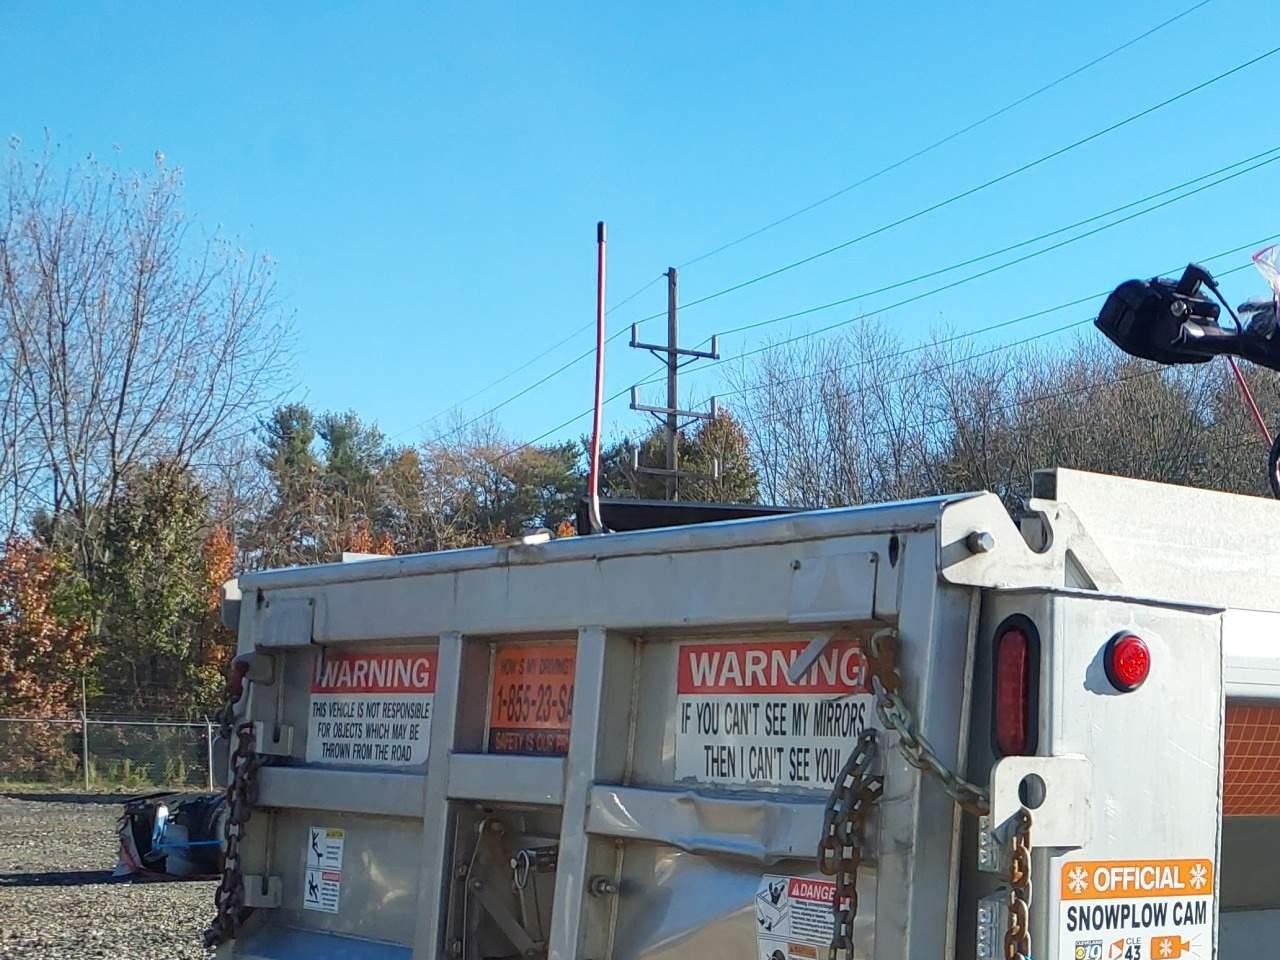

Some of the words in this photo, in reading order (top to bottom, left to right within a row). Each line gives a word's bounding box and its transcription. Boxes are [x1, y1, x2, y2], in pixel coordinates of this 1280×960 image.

[315, 658, 430, 688] WARNING
[689, 648, 866, 687] WARNNG
[313, 702, 327, 718] THIS
[328, 702, 355, 718] VEHICLE
[357, 702, 365, 718] IS
[366, 702, 381, 719] NOT
[382, 702, 430, 719] RESPONSIBLE
[681, 703, 692, 734] IF
[695, 703, 720, 735] YOU
[724, 702, 760, 736] CAN'T
[765, 702, 788, 736] SEE
[791, 703, 810, 737] MY
[317, 722, 332, 738] FOR
[333, 722, 362, 739] OBJECTS
[366, 723, 390, 739] WHICH
[392, 723, 408, 740] MAY
[409, 724, 420, 741] BE
[322, 742, 351, 759] THROWN
[352, 743, 373, 760] FROM
[374, 744, 389, 760] THE
[391, 744, 412, 761] ROAD
[704, 745, 736, 778] THEN
[740, 747, 744, 778] I
[748, 746, 784, 781] CAN'T
[789, 748, 810, 782] SEE
[800, 883, 837, 901] DANGE
[1093, 866, 1185, 892] OFFICIAL
[1067, 902, 1168, 932] SNOWPLOW
[1172, 900, 1207, 926] CAM
[1126, 937, 1142, 945] CLE
